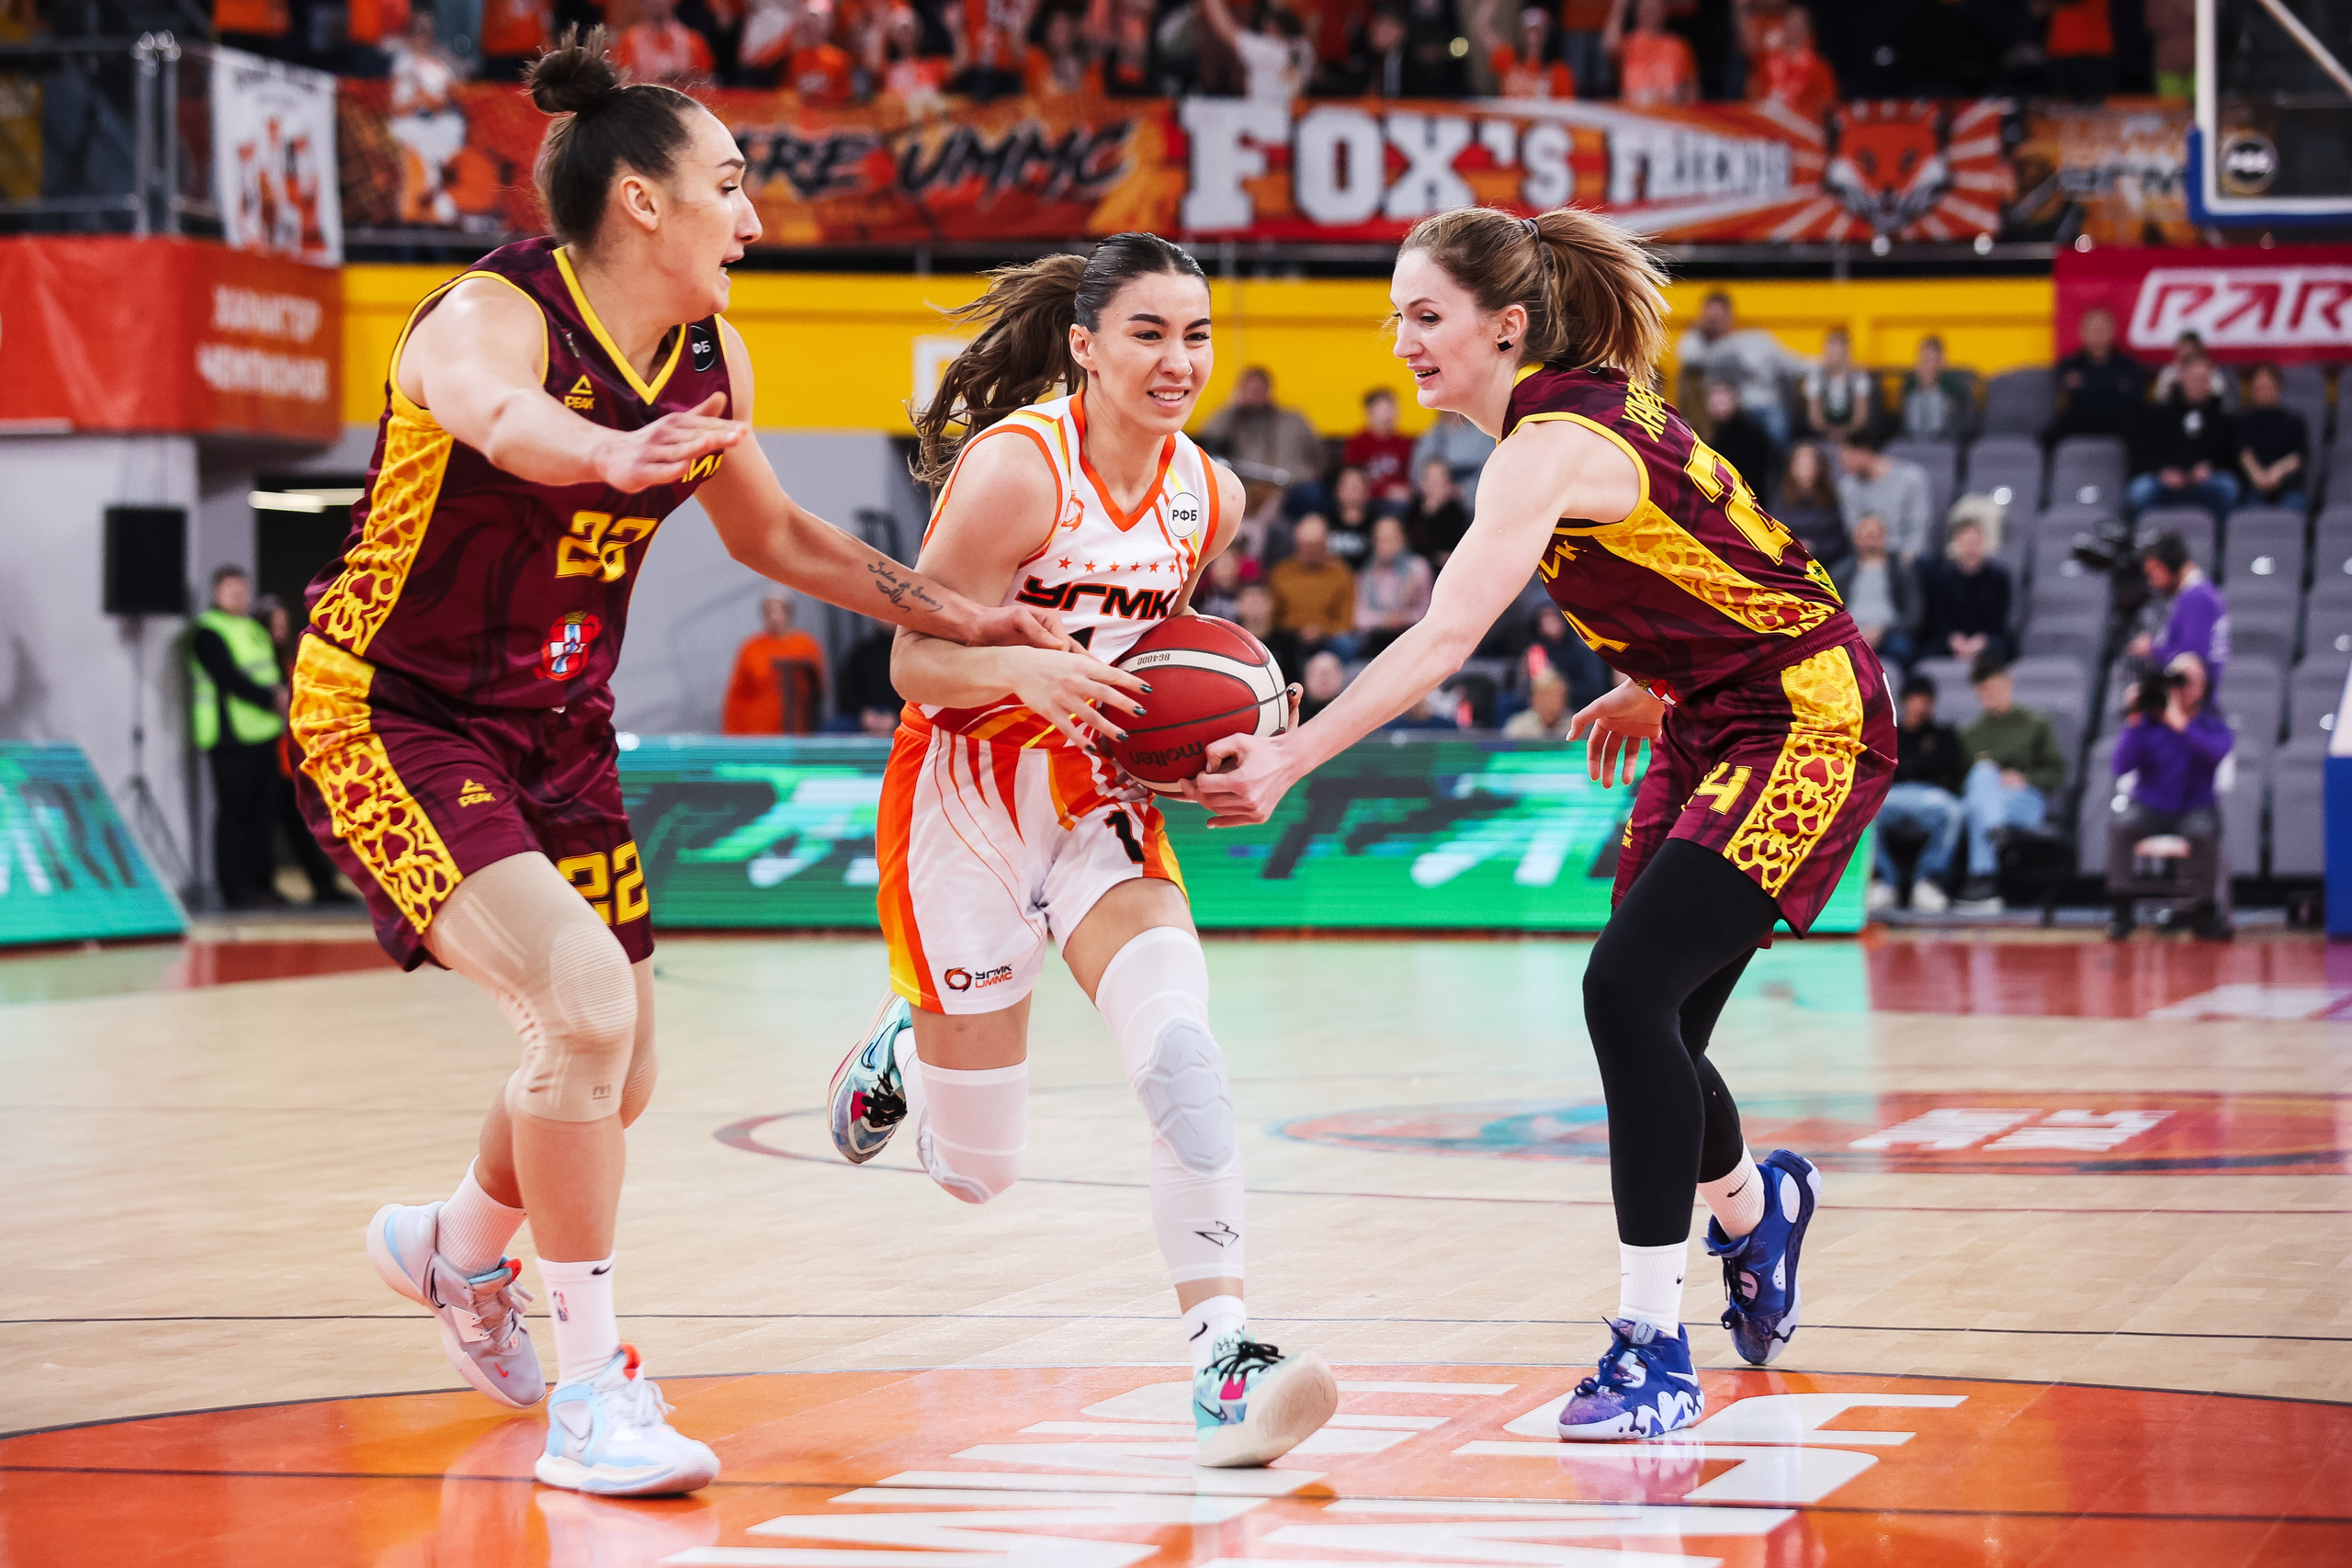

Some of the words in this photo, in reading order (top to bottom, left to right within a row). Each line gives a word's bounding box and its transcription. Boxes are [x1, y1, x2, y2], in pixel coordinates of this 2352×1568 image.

[897, 119, 1139, 204] UMMC
[692, 340, 711, 355] ФБ
[564, 396, 594, 410] PEAK
[1171, 509, 1197, 522] РФБ
[555, 510, 658, 582] 22
[1014, 574, 1180, 620] УГМК
[1136, 653, 1170, 666] BG4000
[1128, 740, 1204, 766] molten
[1103, 809, 1146, 864] 1
[556, 840, 650, 927] 22
[975, 964, 1012, 980] УГМК
[975, 972, 1012, 988] UMMC
